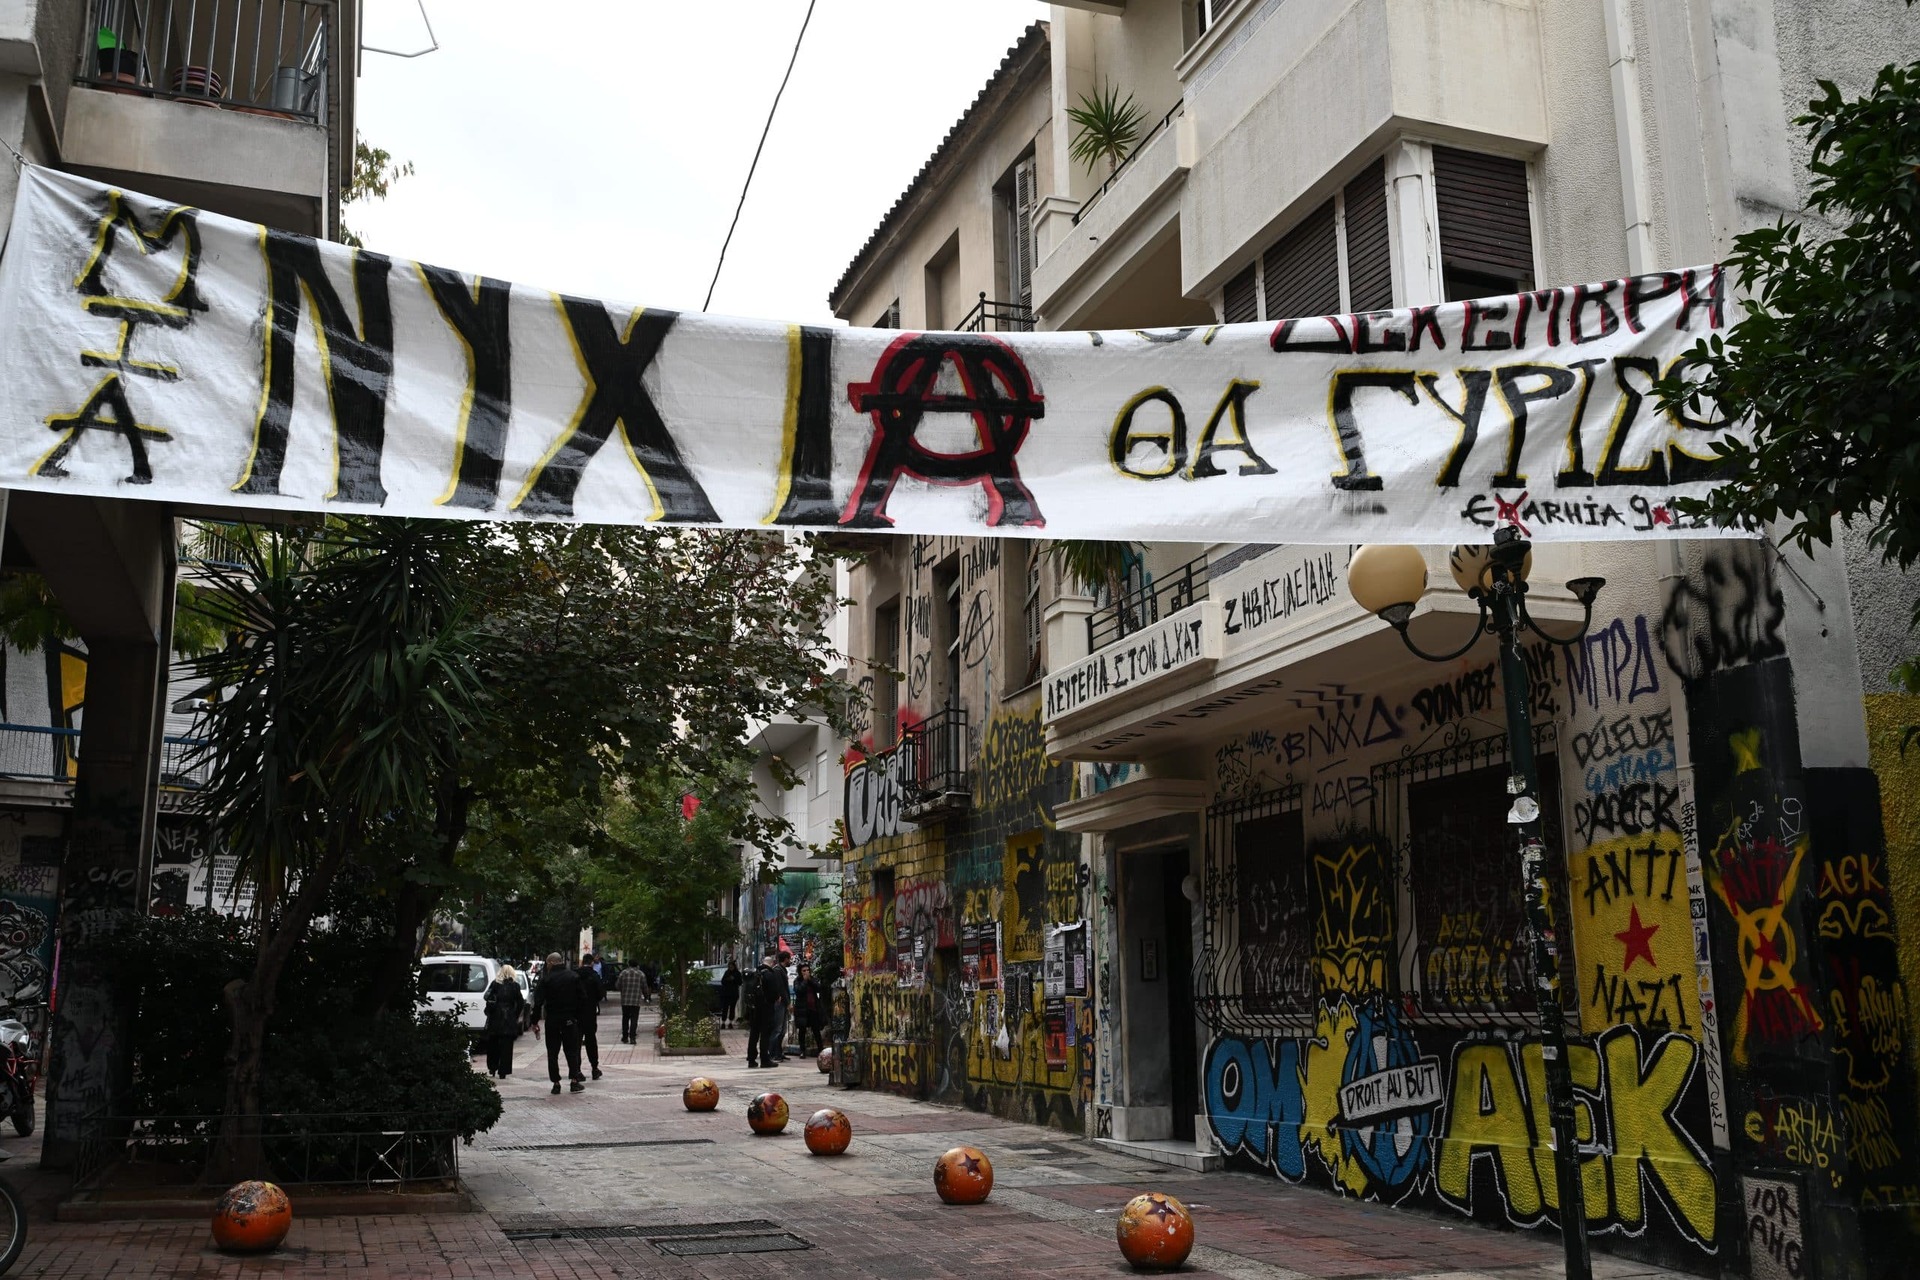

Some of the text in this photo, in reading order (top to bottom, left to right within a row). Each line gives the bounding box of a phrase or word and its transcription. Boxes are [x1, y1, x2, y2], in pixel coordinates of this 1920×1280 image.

[1109, 378, 1279, 481] ΘΑ
[1047, 654, 1109, 719] ΛΕΥΤΕΡΙΑ
[1113, 637, 1157, 688] ΣΤΟΝ
[1584, 842, 1682, 916] ANTI
[1592, 963, 1693, 1031] NAZI
[1346, 1066, 1435, 1114] DROIT AU BUT
